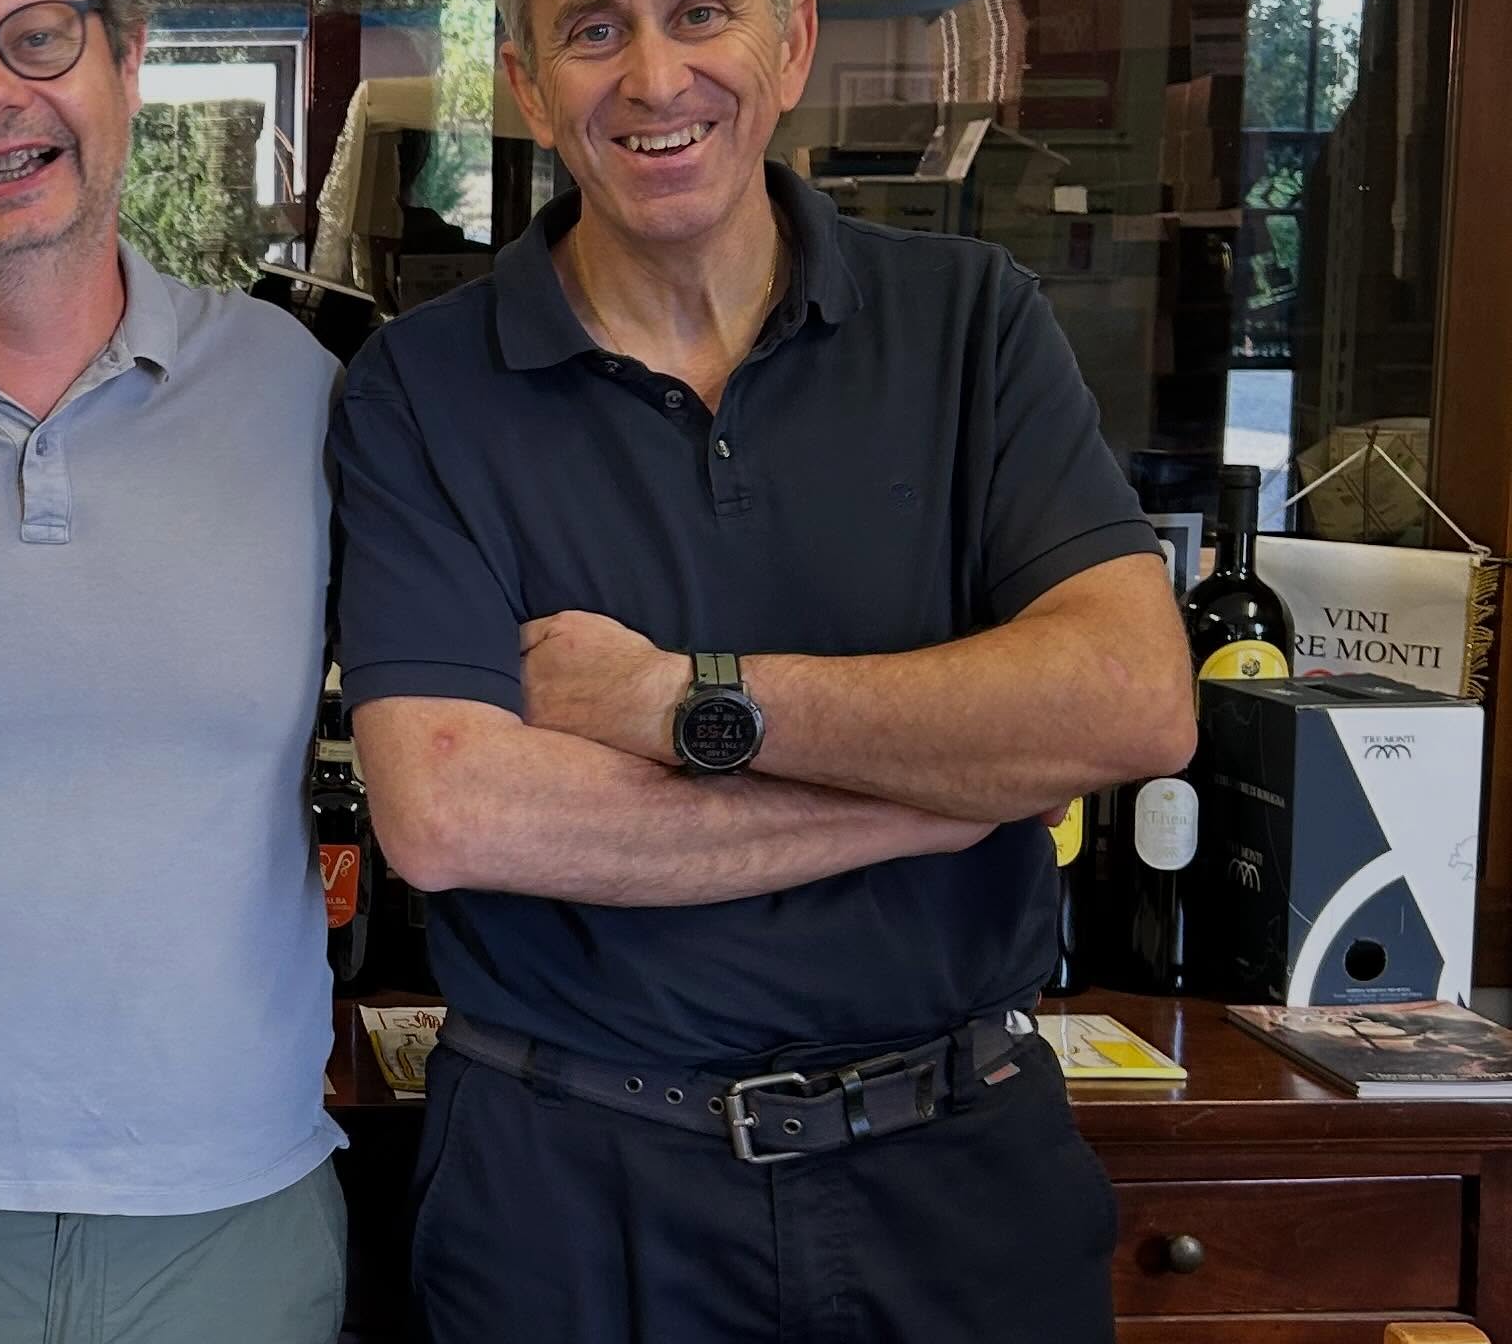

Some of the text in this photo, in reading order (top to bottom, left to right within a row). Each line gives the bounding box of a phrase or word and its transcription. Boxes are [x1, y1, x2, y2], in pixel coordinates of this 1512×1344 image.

[1323, 607, 1390, 634] VINI
[1294, 634, 1443, 668] RE MONTI
[1383, 735, 1416, 744] MONTI
[327, 896, 347, 905] ALBA
